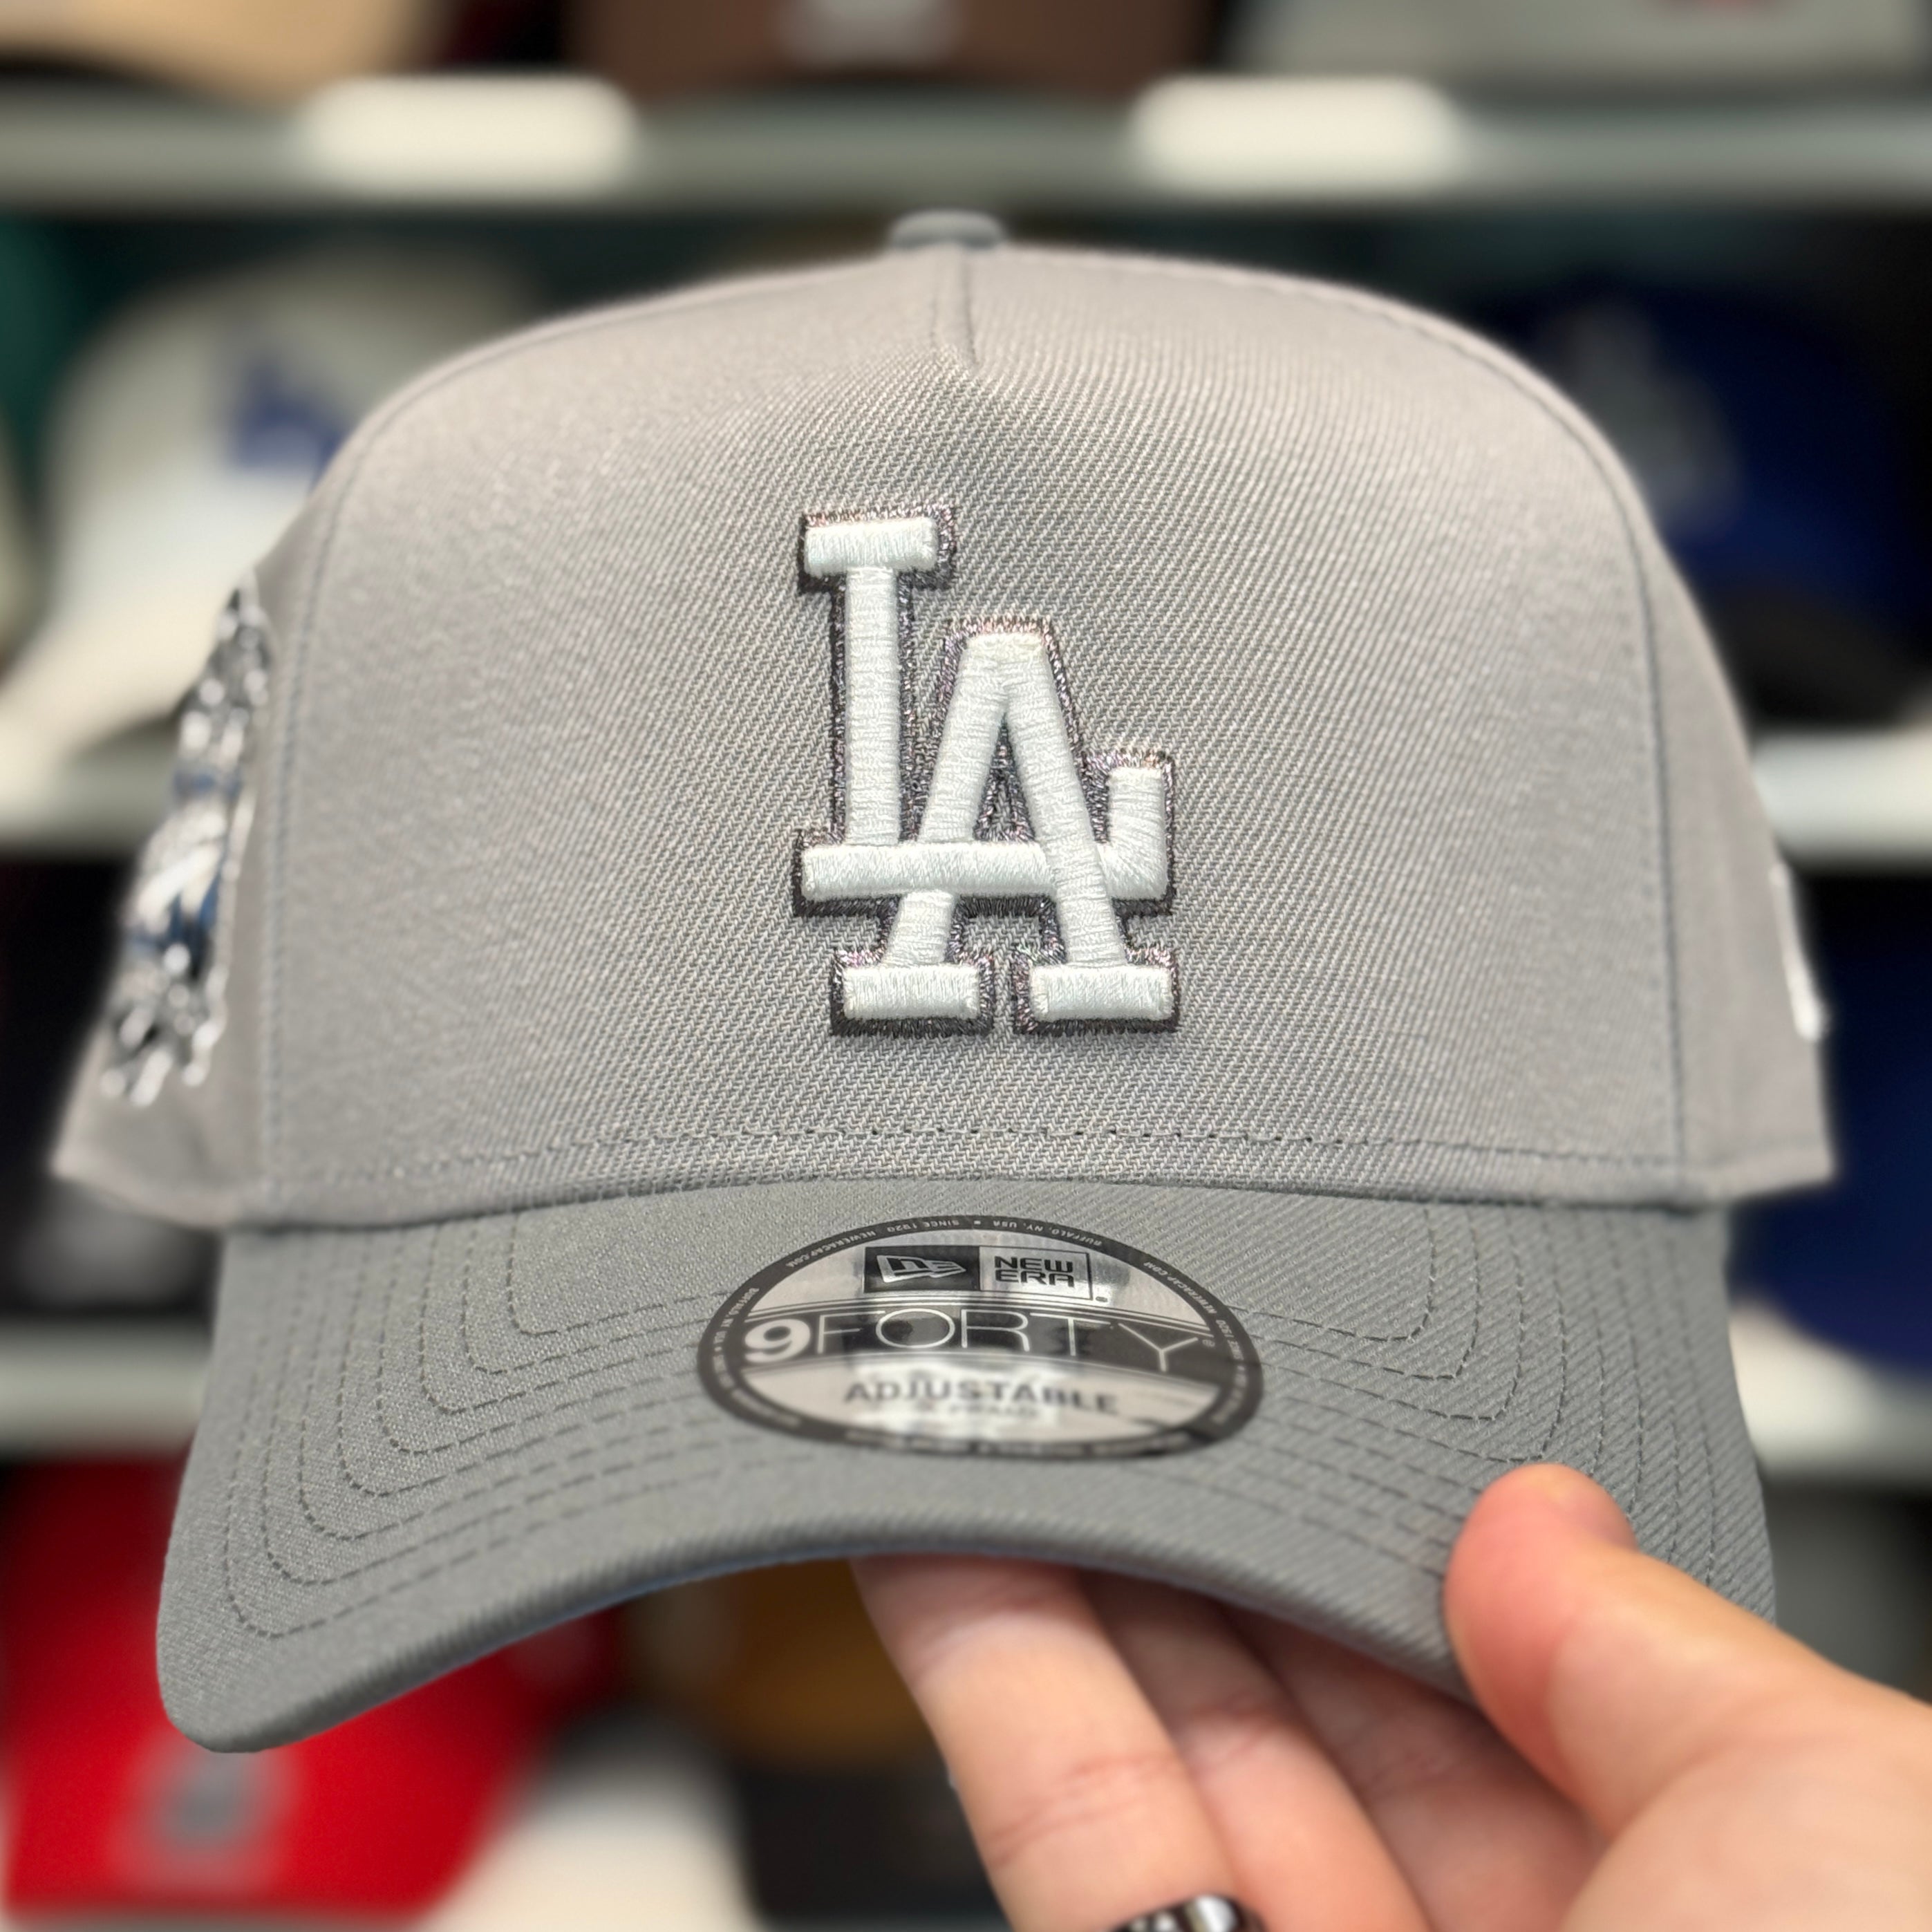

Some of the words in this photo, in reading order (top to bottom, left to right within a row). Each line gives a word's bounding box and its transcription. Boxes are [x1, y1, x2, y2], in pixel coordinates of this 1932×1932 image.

[796, 508, 1177, 1028] LA
[923, 1219, 959, 1229] SINCE
[993, 1220, 1017, 1229] USA
[994, 1255, 1073, 1273] NEW
[995, 1269, 1075, 1288] ERA
[744, 1308, 1200, 1371] 9FORTY
[843, 1380, 1120, 1415] ADJUSTABLE
